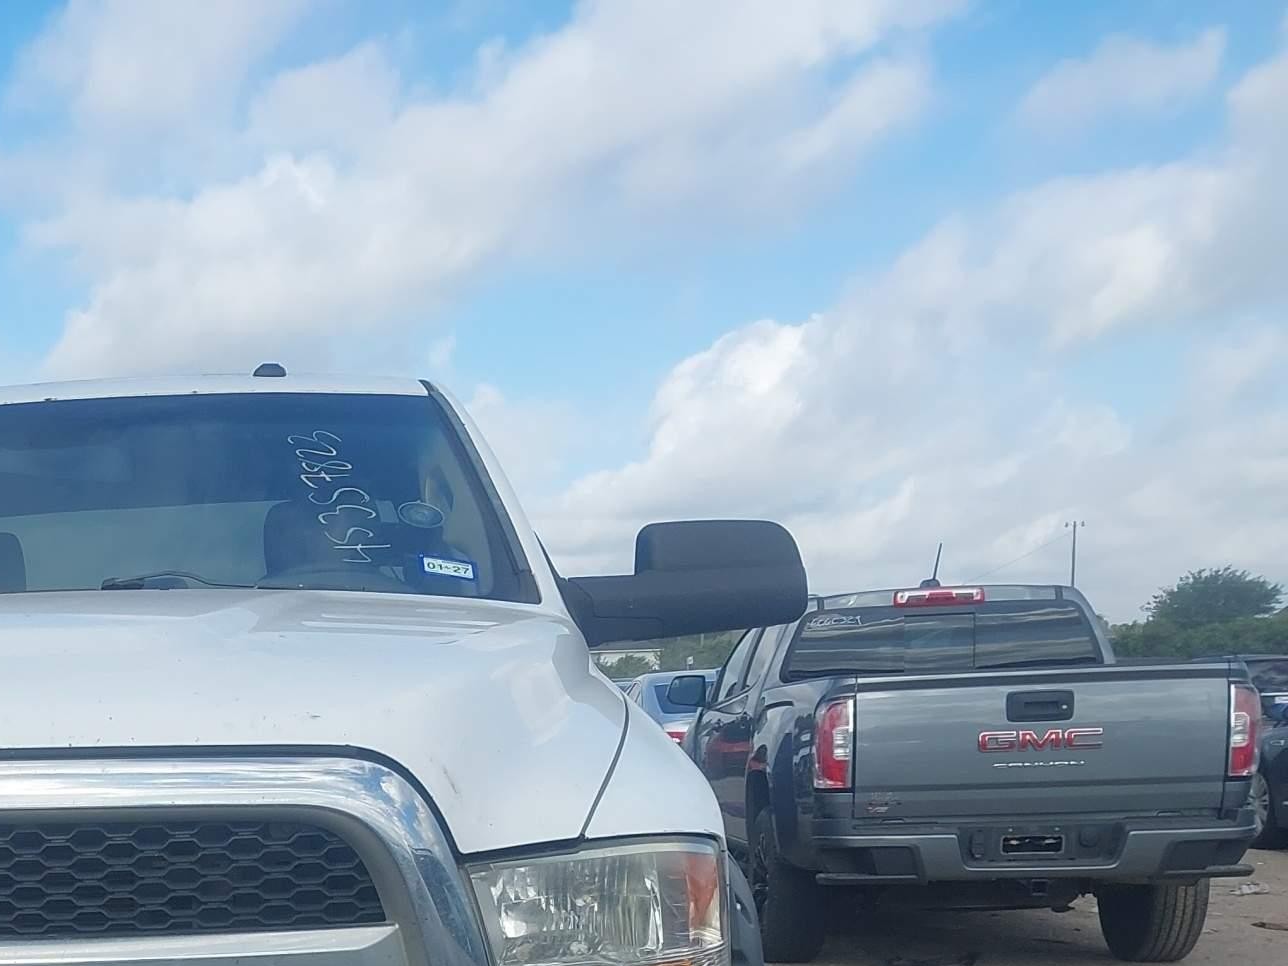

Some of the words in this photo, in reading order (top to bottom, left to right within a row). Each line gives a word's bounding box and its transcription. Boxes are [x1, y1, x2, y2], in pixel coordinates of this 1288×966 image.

[288, 430, 391, 563] 45357823
[427, 561, 470, 575] 01-27
[978, 728, 1103, 752] GMC
